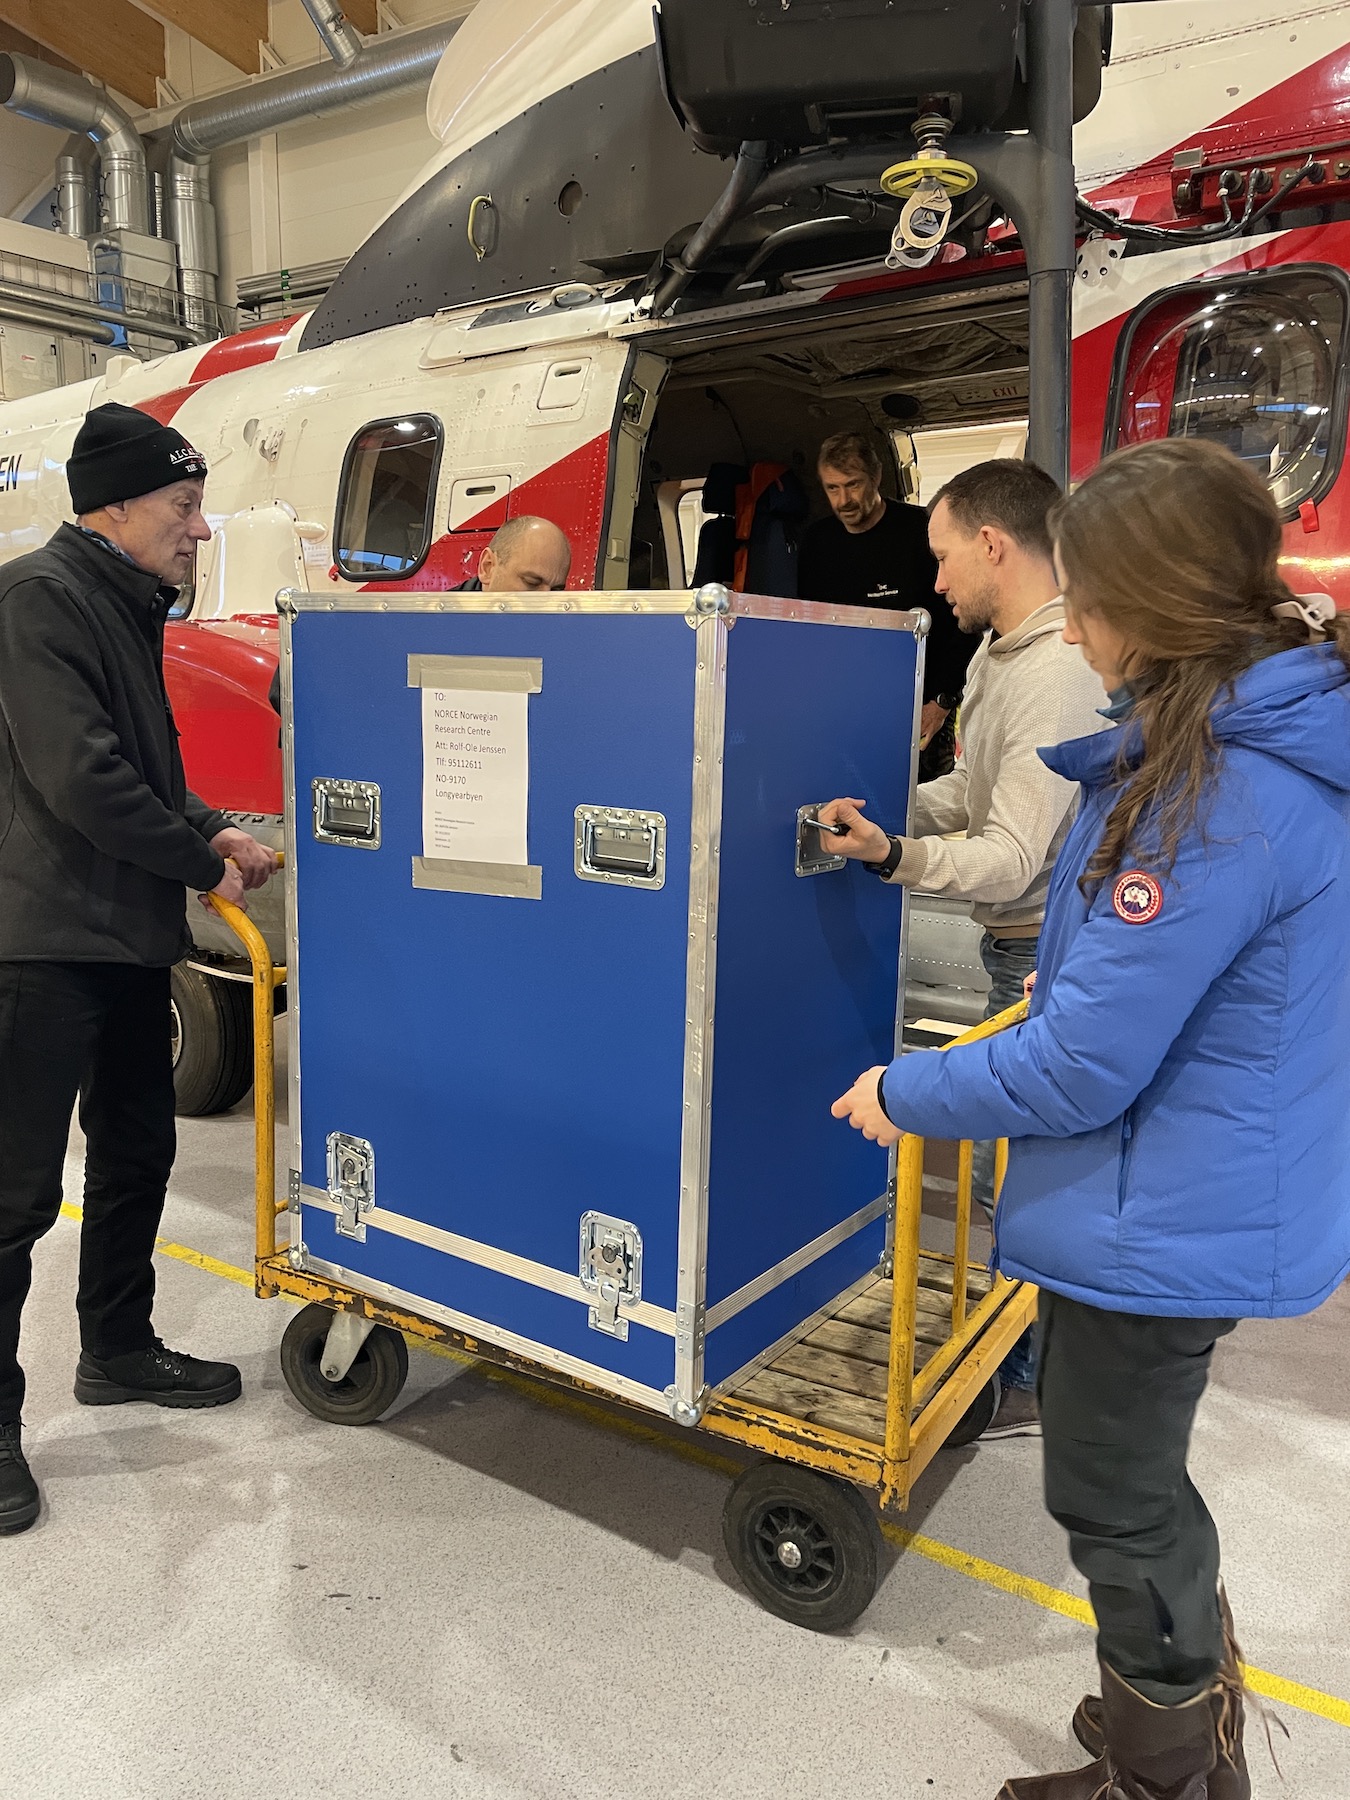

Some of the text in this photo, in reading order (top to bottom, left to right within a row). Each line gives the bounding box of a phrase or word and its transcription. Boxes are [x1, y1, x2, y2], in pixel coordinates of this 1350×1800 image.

[992, 386, 1018, 397] EXIT
[434, 692, 447, 701] TO:
[434, 709, 498, 722] NORCE Norwegian
[434, 724, 491, 736] Research Centre
[435, 741, 507, 754] Att: Rolf-Ole Jenssen
[436, 757, 482, 769] Tlf: 95112611
[436, 774, 467, 785] NO-9170
[435, 788, 483, 802] Longyearbyen
